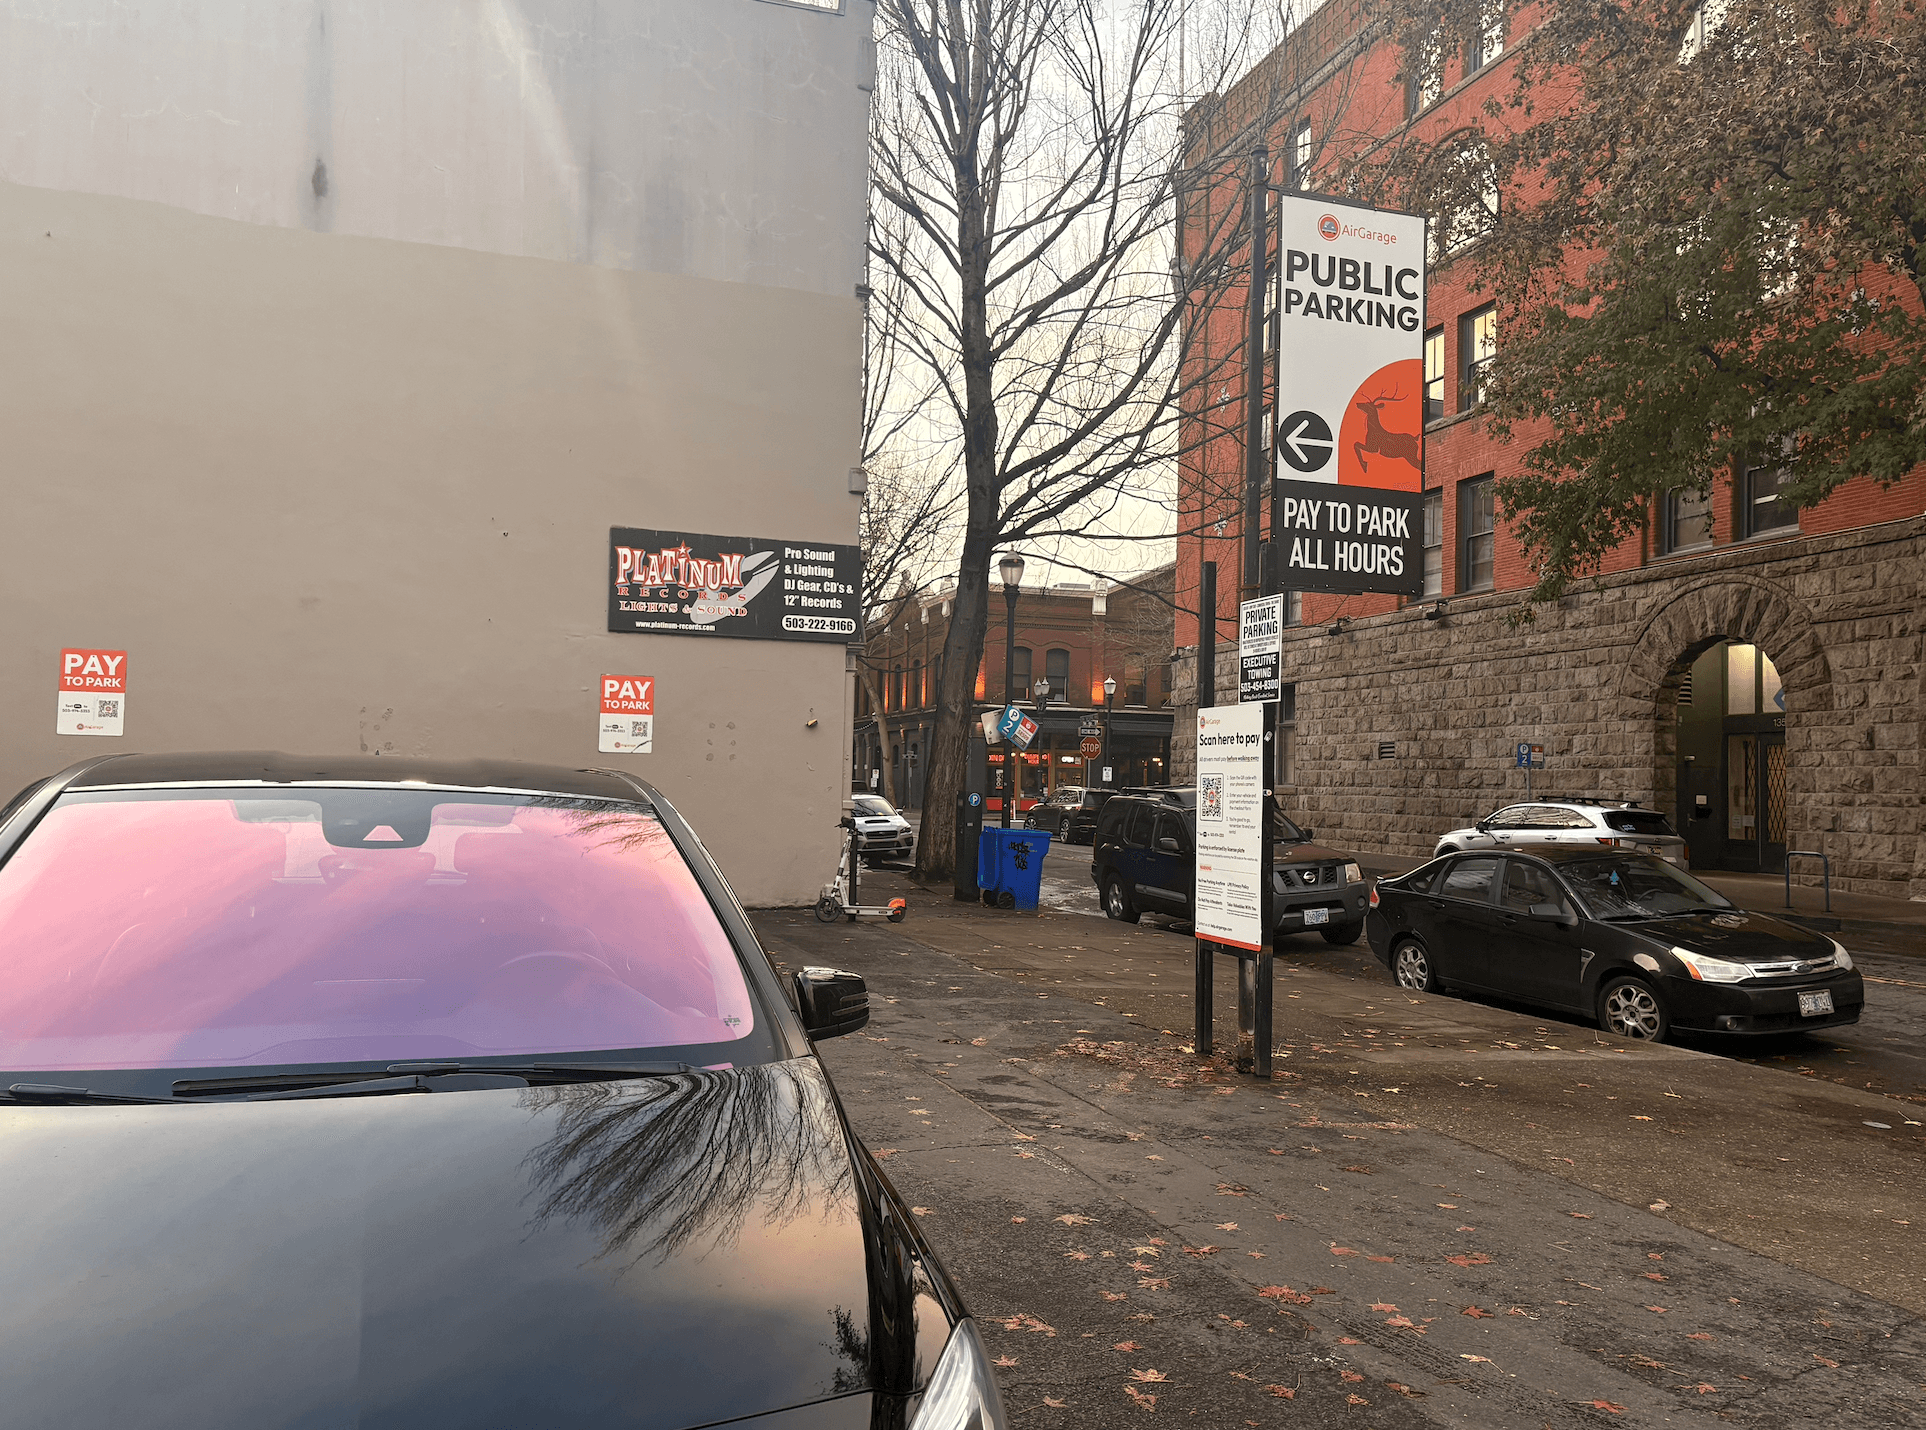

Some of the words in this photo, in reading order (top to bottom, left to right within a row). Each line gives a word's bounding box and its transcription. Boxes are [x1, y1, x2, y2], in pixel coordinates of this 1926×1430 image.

[1341, 224, 1398, 246] AirGarage
[1286, 249, 1420, 301] PUBLIC
[1285, 288, 1420, 332] PARKING
[1283, 497, 1323, 531] PAY
[1325, 501, 1351, 534] TO
[1356, 504, 1411, 539] PARK
[784, 547, 802, 560] Pro
[803, 548, 835, 562] Sound
[1288, 537, 1329, 570] ALL
[1334, 540, 1404, 576] HOURS
[784, 564, 792, 575] &
[793, 564, 834, 578] Lighting
[617, 586, 747, 602] RECORDS
[784, 578, 796, 591] DJ
[797, 579, 822, 593] Gear,
[823, 581, 845, 594] CD's
[846, 584, 854, 595] &
[619, 600, 678, 614] LIGHTS
[682, 604, 692, 615] &
[697, 604, 748, 617] SOUND
[800, 595, 843, 609] Records
[1245, 606, 1276, 625] PRIVATE
[635, 621, 716, 632] www.platinum-records.com
[785, 617, 853, 632] 503-222-9166
[1243, 620, 1278, 639] PARKING
[64, 653, 123, 676] PAY
[1243, 654, 1277, 668] EXECUTIVE
[1247, 667, 1272, 679] TOWING
[64, 676, 84, 686] TO
[86, 677, 122, 688] PARK
[604, 679, 652, 700] PAY
[604, 699, 620, 709] TO
[621, 700, 650, 710] PARK
[1002, 720, 1014, 733] 2
[1199, 733, 1217, 746] Scan
[1217, 732, 1235, 746] here
[1236, 732, 1245, 745] to
[1245, 733, 1261, 748] pay
[1081, 743, 1100, 753] STOP
[1521, 754, 1528, 764] 2
[1198, 843, 1208, 851] Parking
